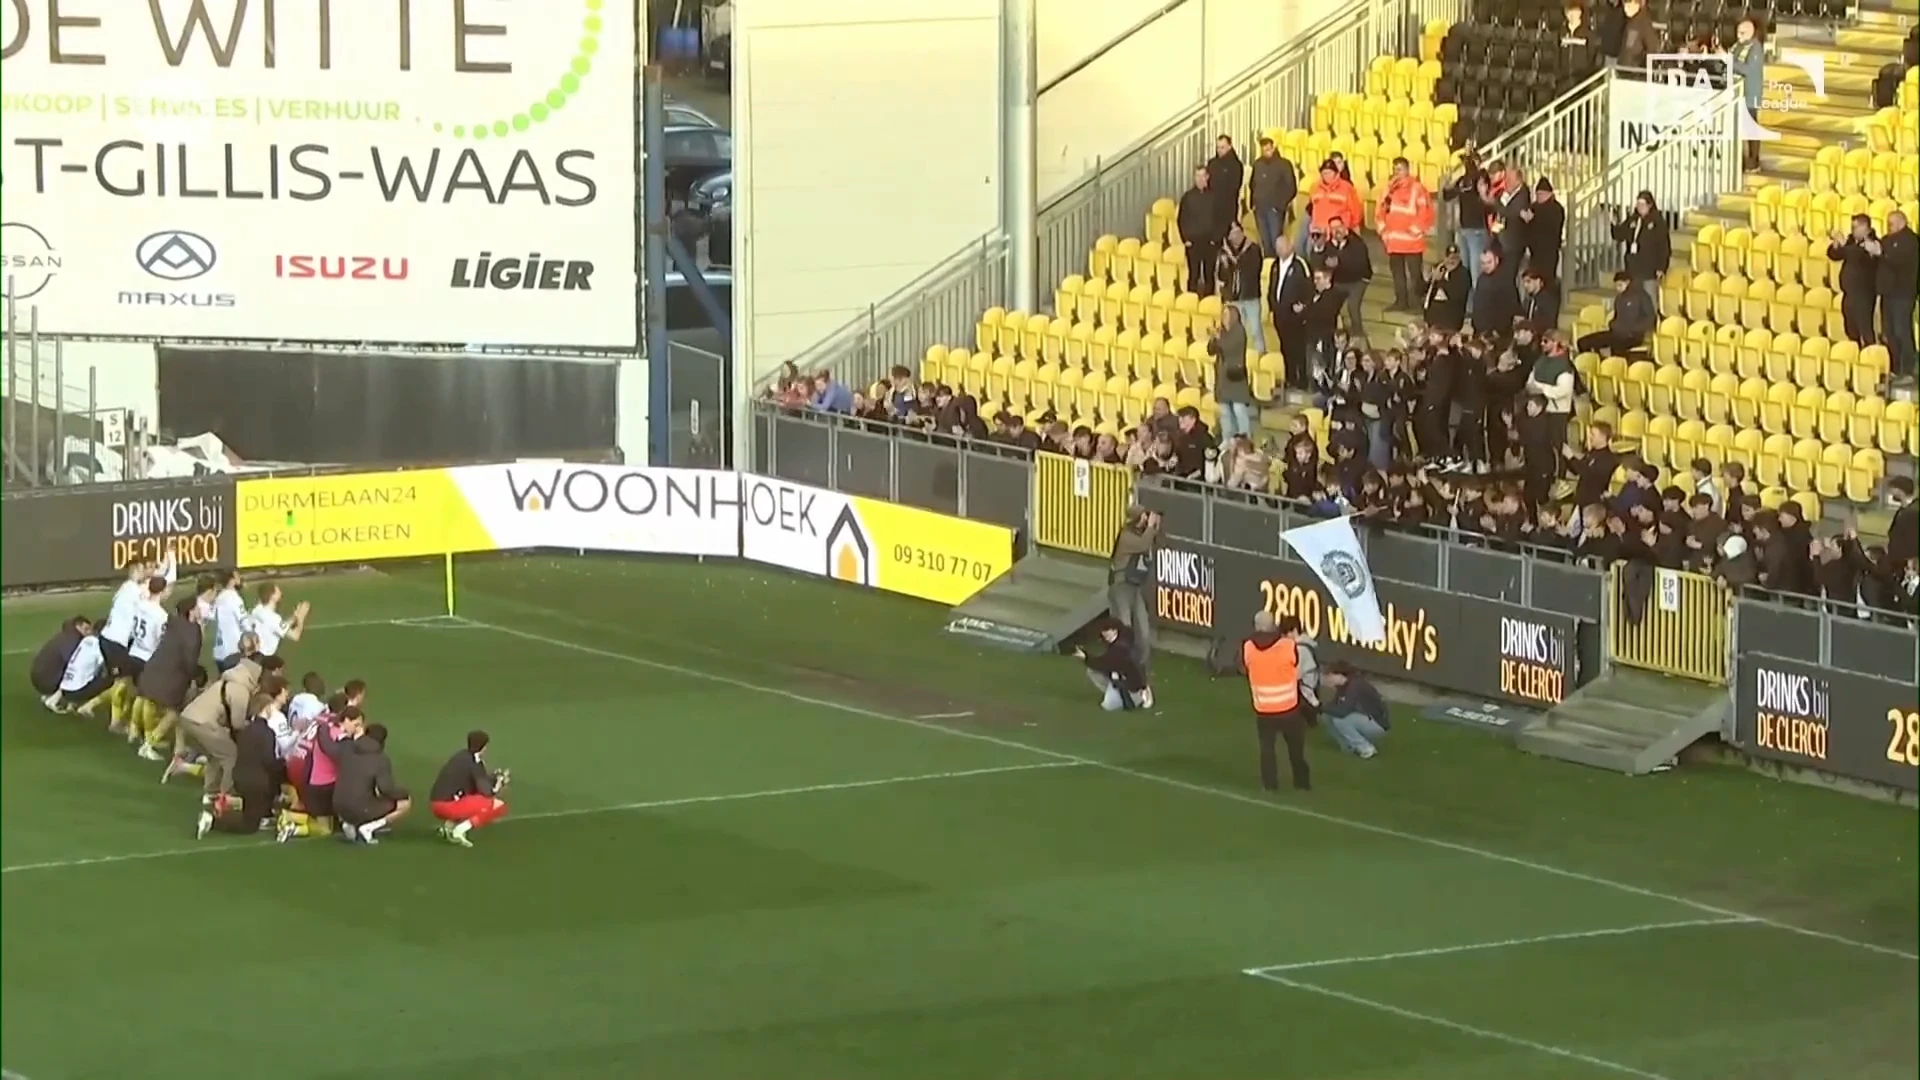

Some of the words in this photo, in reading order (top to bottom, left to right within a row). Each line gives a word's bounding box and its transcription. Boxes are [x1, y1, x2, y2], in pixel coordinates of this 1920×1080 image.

[268, 99, 400, 121] VERHUUR
[275, 254, 408, 280] ISUZU
[118, 291, 236, 307] MAXUS
[108, 430, 122, 443] 12
[112, 497, 193, 537] DRINKS
[199, 495, 224, 538] bij
[506, 468, 818, 537] WOONHOEK
[113, 538, 139, 570] DE
[247, 530, 304, 550] 9160
[310, 524, 412, 546] LOKEREN
[894, 544, 912, 564] 09
[916, 548, 945, 572] 310
[950, 556, 968, 577] 77
[972, 562, 992, 582] 07
[1157, 548, 1199, 589] DRINKS
[1200, 555, 1215, 602] bij
[133, 615, 147, 639] 25
[1157, 585, 1171, 619] DE
[1172, 589, 1213, 628] CLERCQ
[1260, 579, 1320, 641] 2800
[1327, 602, 1438, 671] wky's
[1501, 616, 1548, 663] DRINKS
[1550, 626, 1565, 677] bij
[1501, 658, 1516, 694] DE
[1517, 663, 1562, 704] CLERCQ
[1757, 667, 1810, 716] DRINKS
[1812, 678, 1830, 731] bij
[1757, 711, 1774, 748] DE
[1776, 715, 1827, 760] CLERCQ
[1886, 707, 1919, 767] 28
